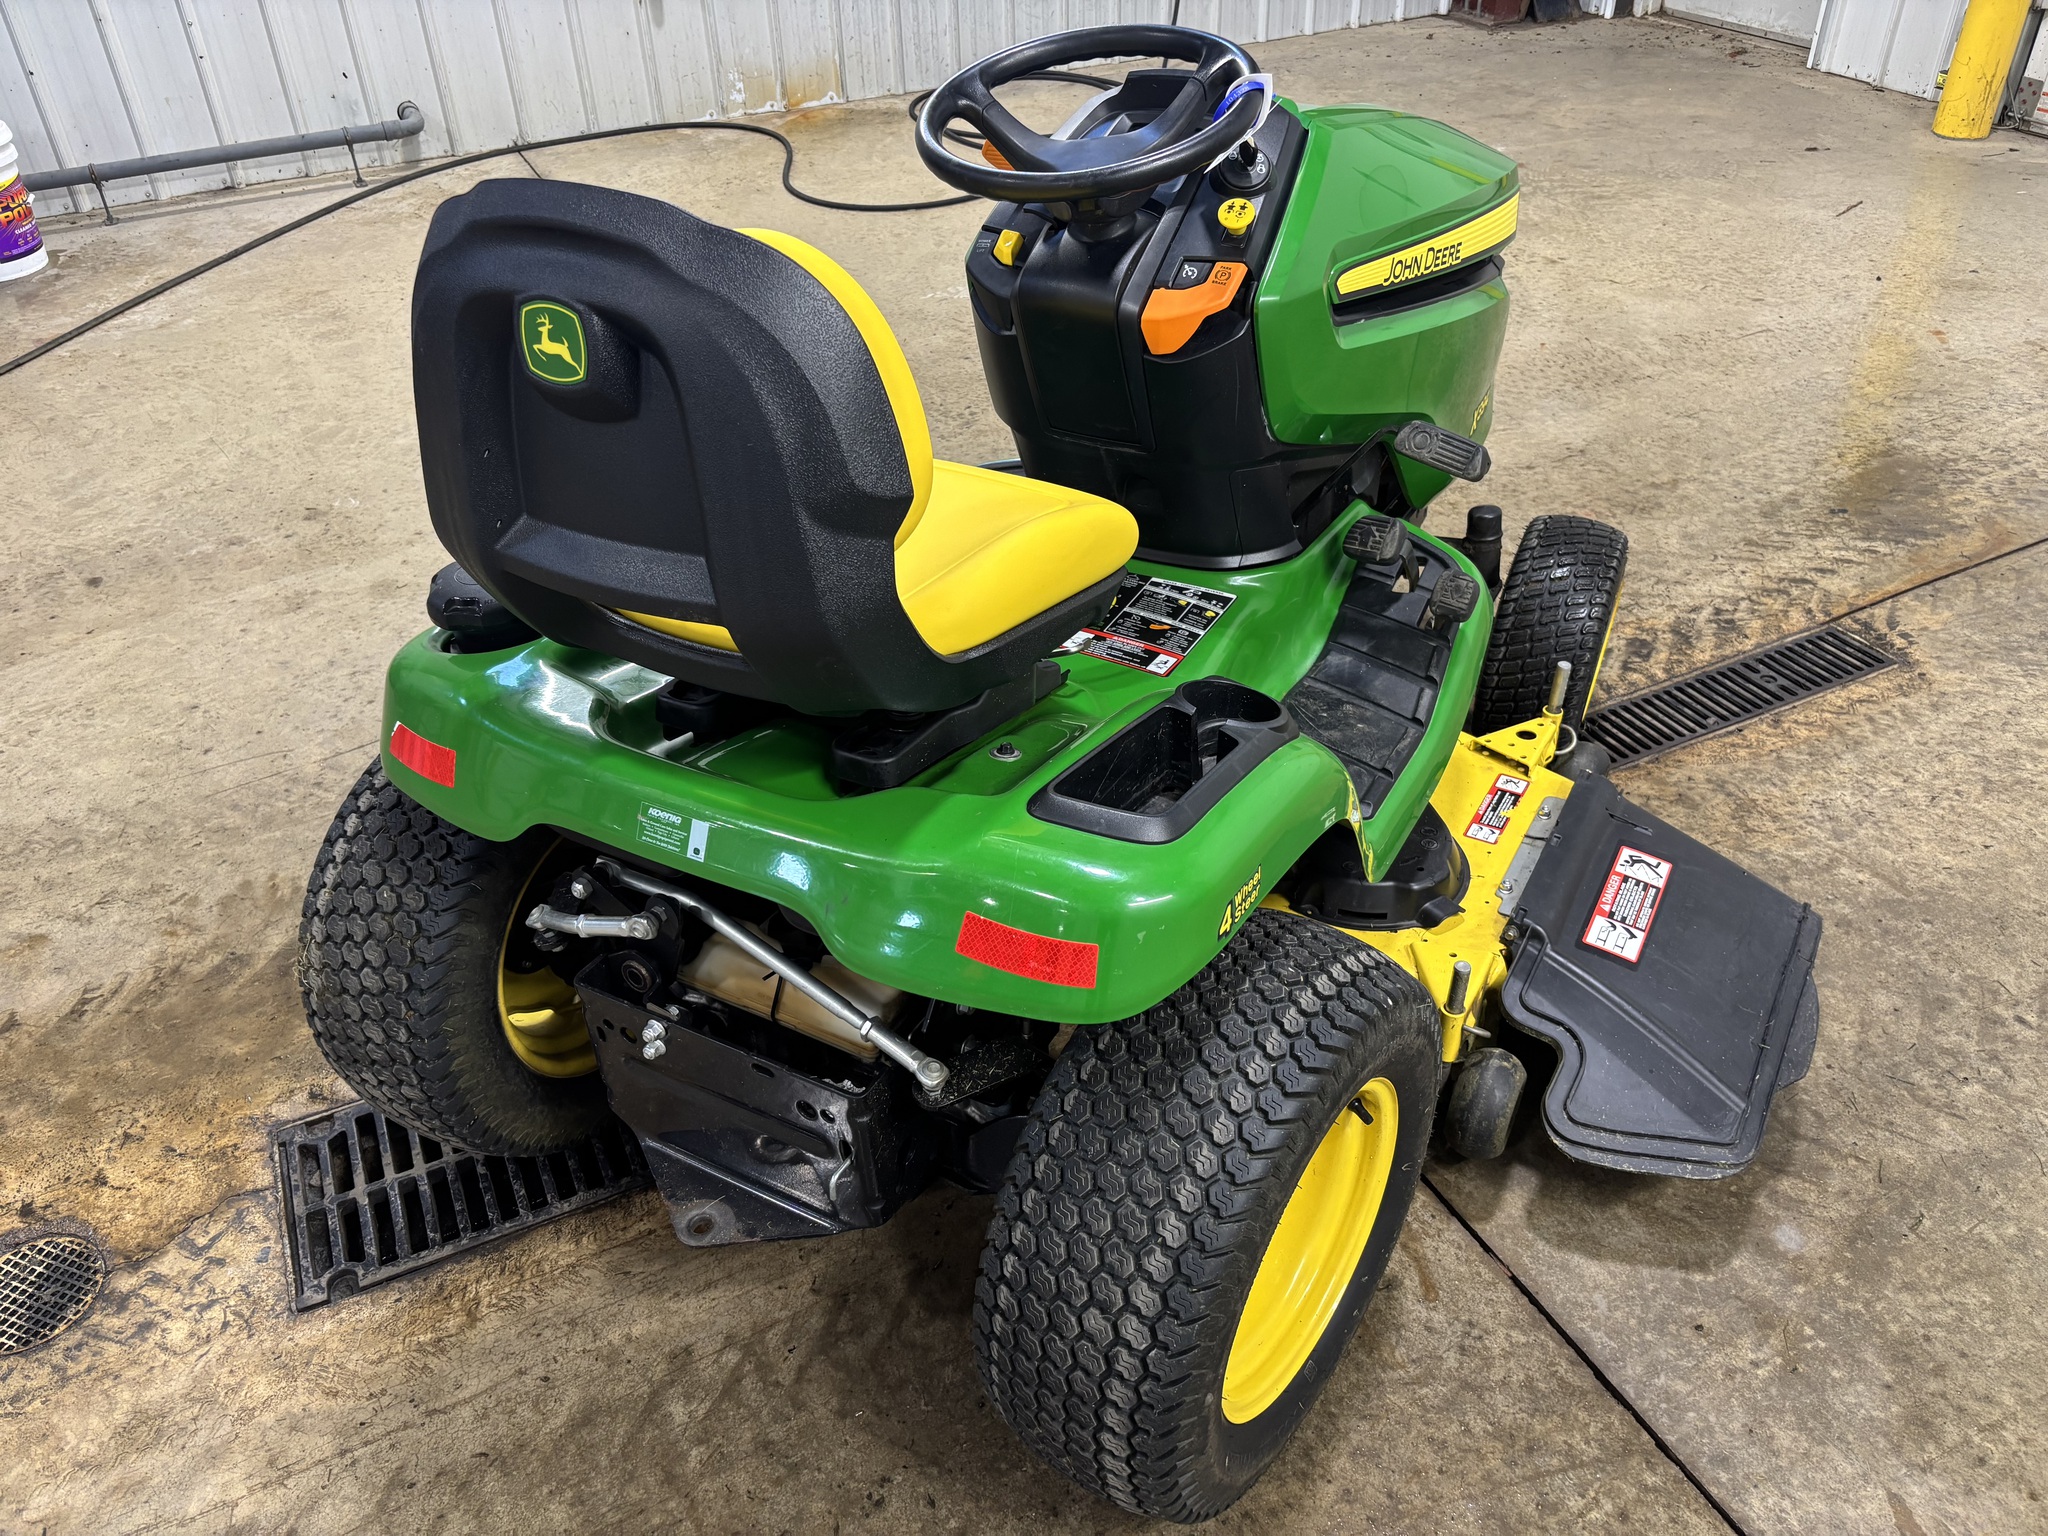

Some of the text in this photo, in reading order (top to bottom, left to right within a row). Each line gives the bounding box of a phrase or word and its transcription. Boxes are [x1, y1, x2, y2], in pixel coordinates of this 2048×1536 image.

[1383, 241, 1463, 285] JOHN DEERE
[1234, 864, 1262, 907] Wheel
[1234, 884, 1261, 923] Steer
[1602, 874, 1622, 904] DANGER
[1218, 903, 1233, 936] 4
